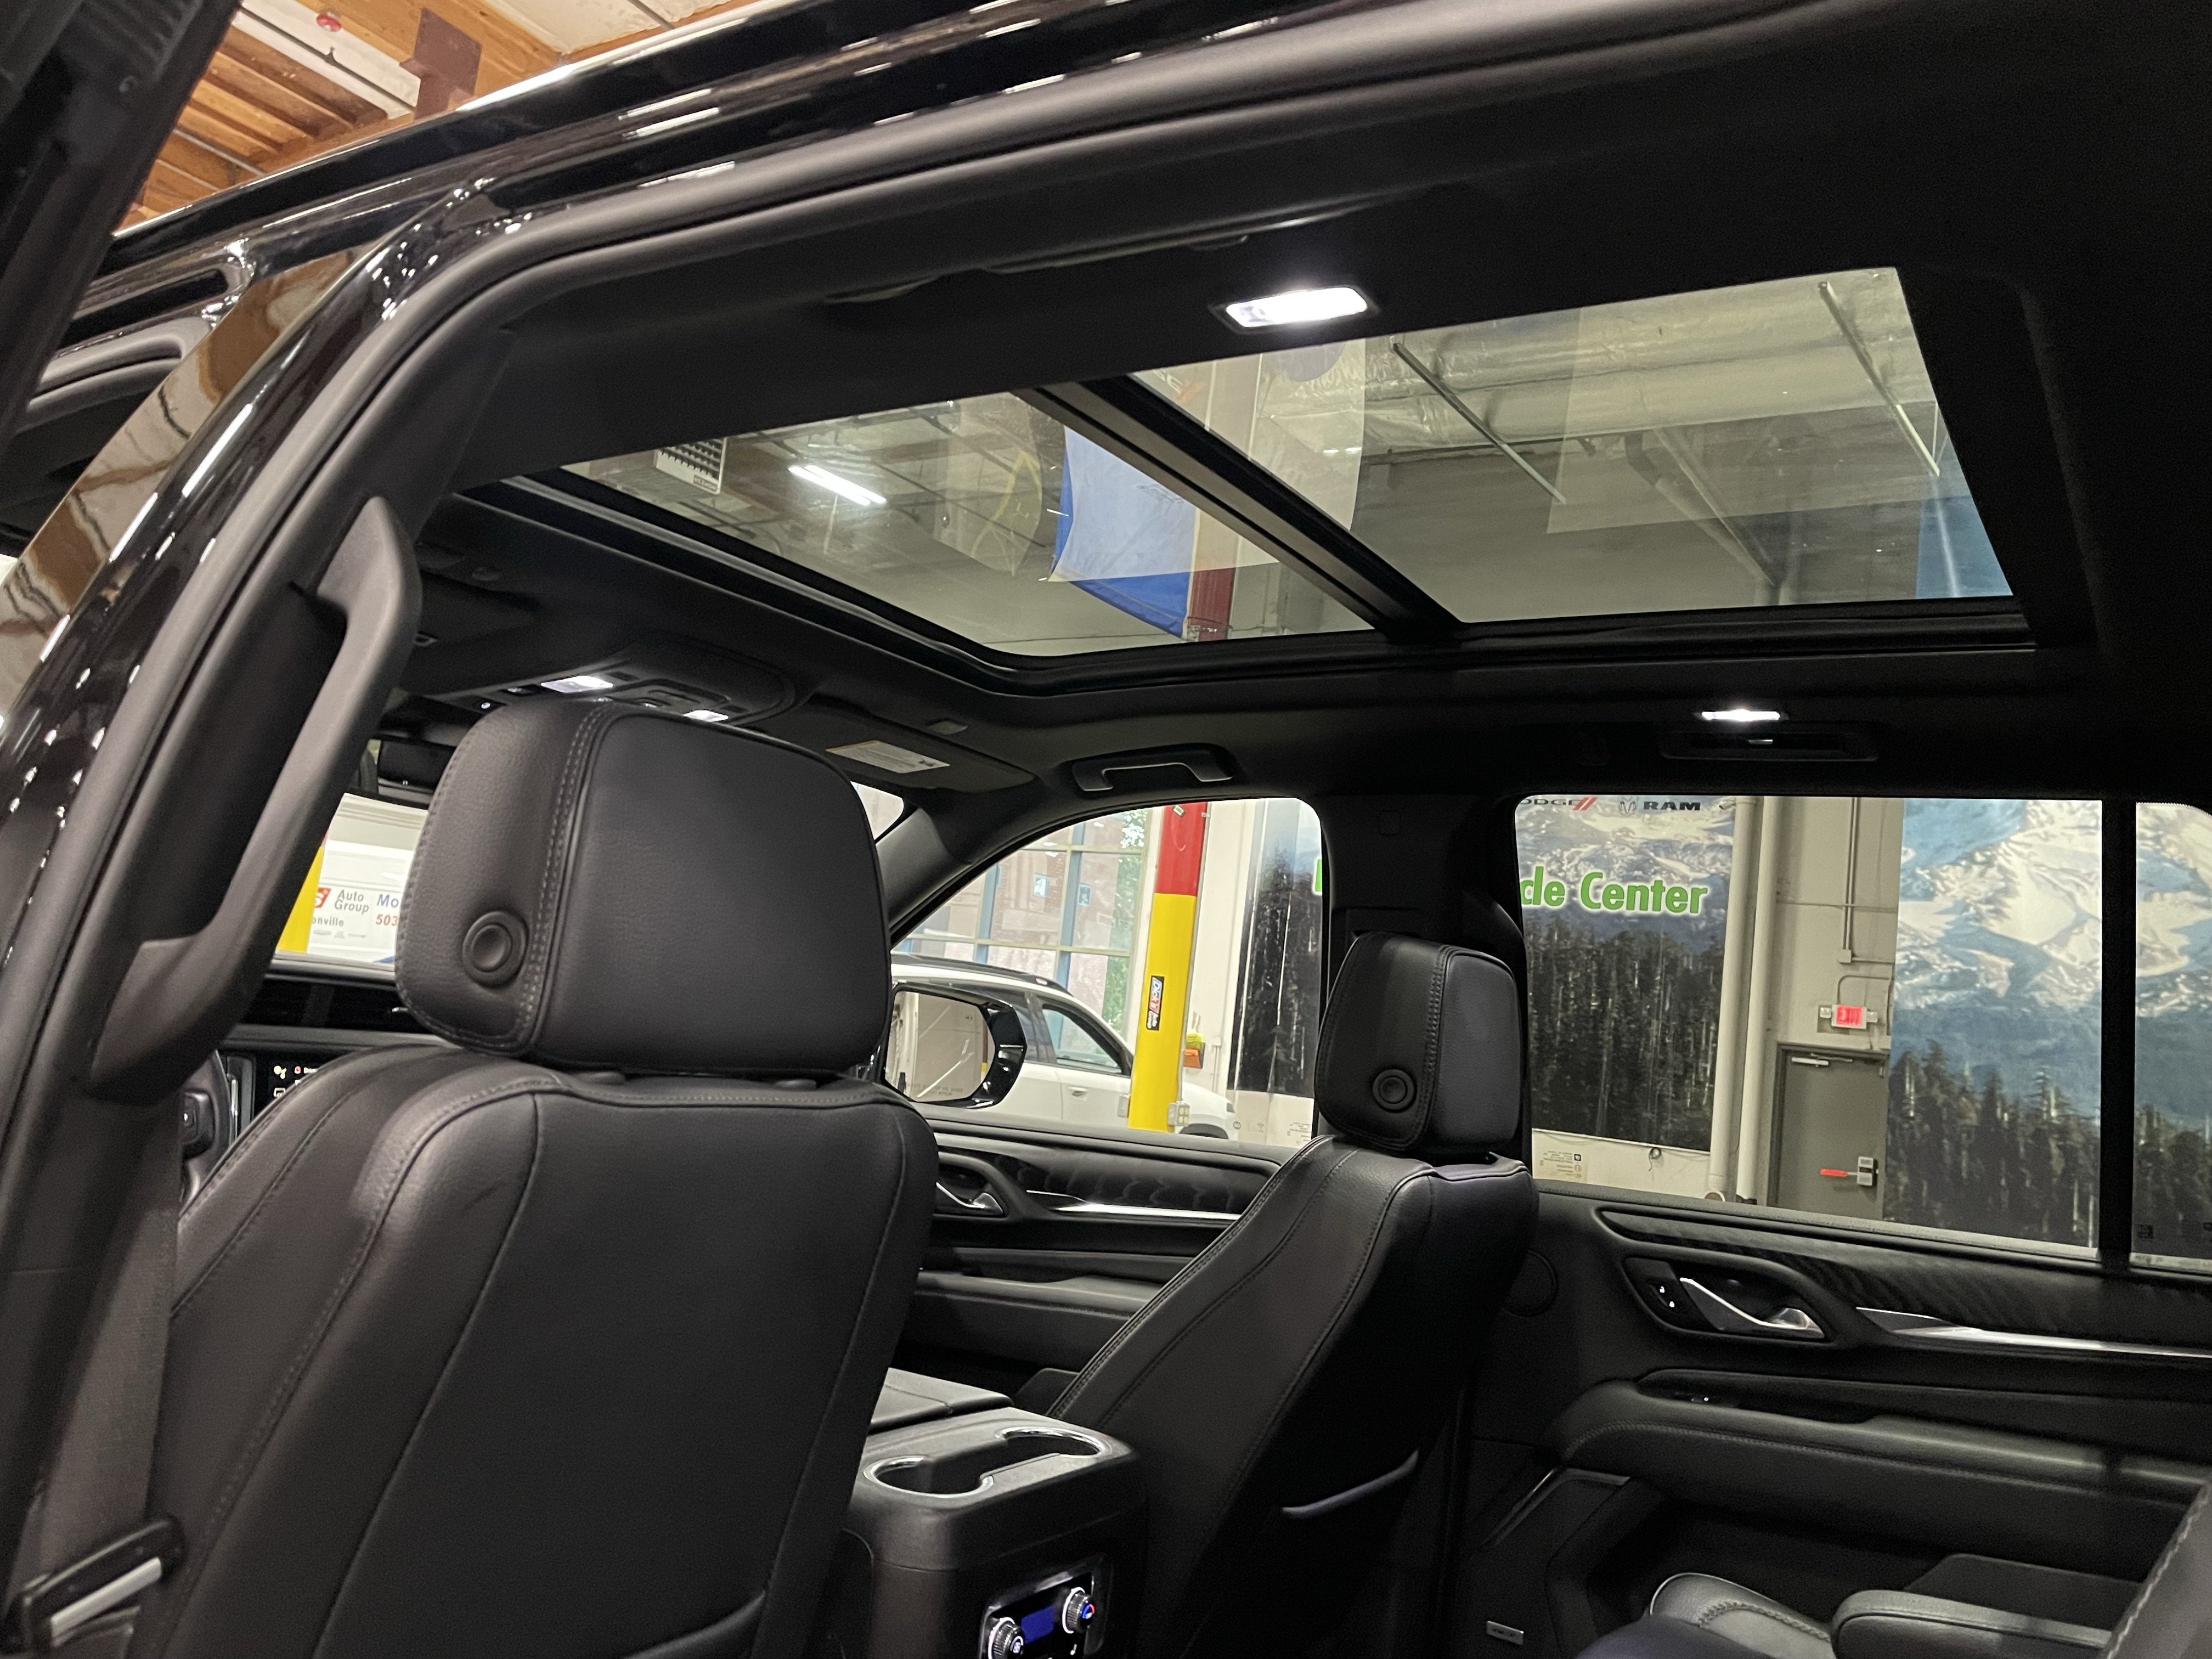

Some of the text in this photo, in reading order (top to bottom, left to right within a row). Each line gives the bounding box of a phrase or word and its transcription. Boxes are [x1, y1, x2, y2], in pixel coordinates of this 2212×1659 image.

[1643, 801, 1701, 811] RAM
[337, 889, 364, 902] Auto
[1581, 872, 1708, 913] Center
[334, 899, 369, 915] Group
[377, 894, 399, 908] Mo
